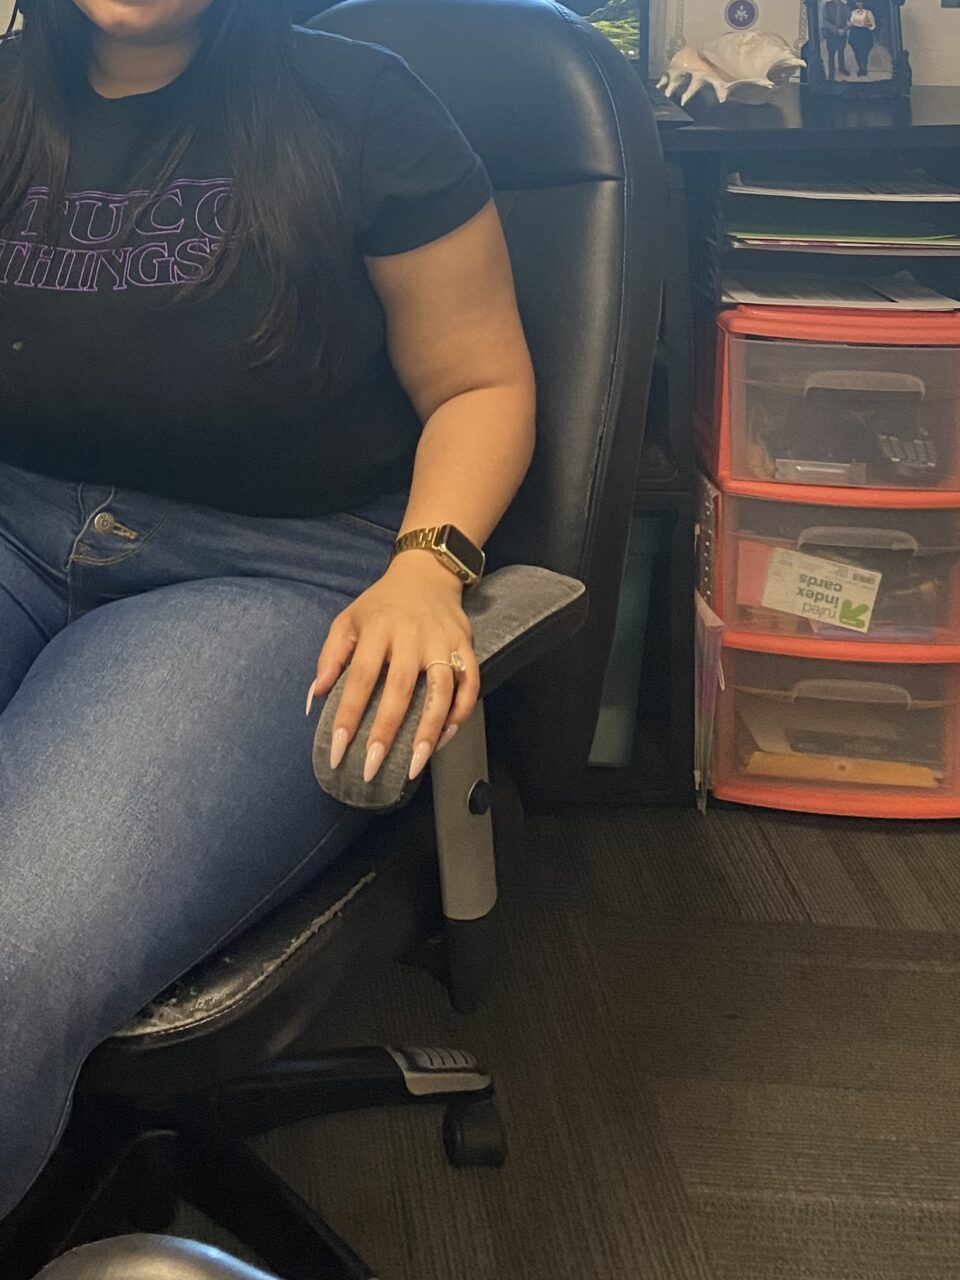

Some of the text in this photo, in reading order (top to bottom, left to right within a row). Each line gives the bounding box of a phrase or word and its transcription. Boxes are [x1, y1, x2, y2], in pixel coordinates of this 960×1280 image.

[800, 574, 843, 592] cards
[797, 586, 840, 608] index
[802, 602, 837, 619] ruled
